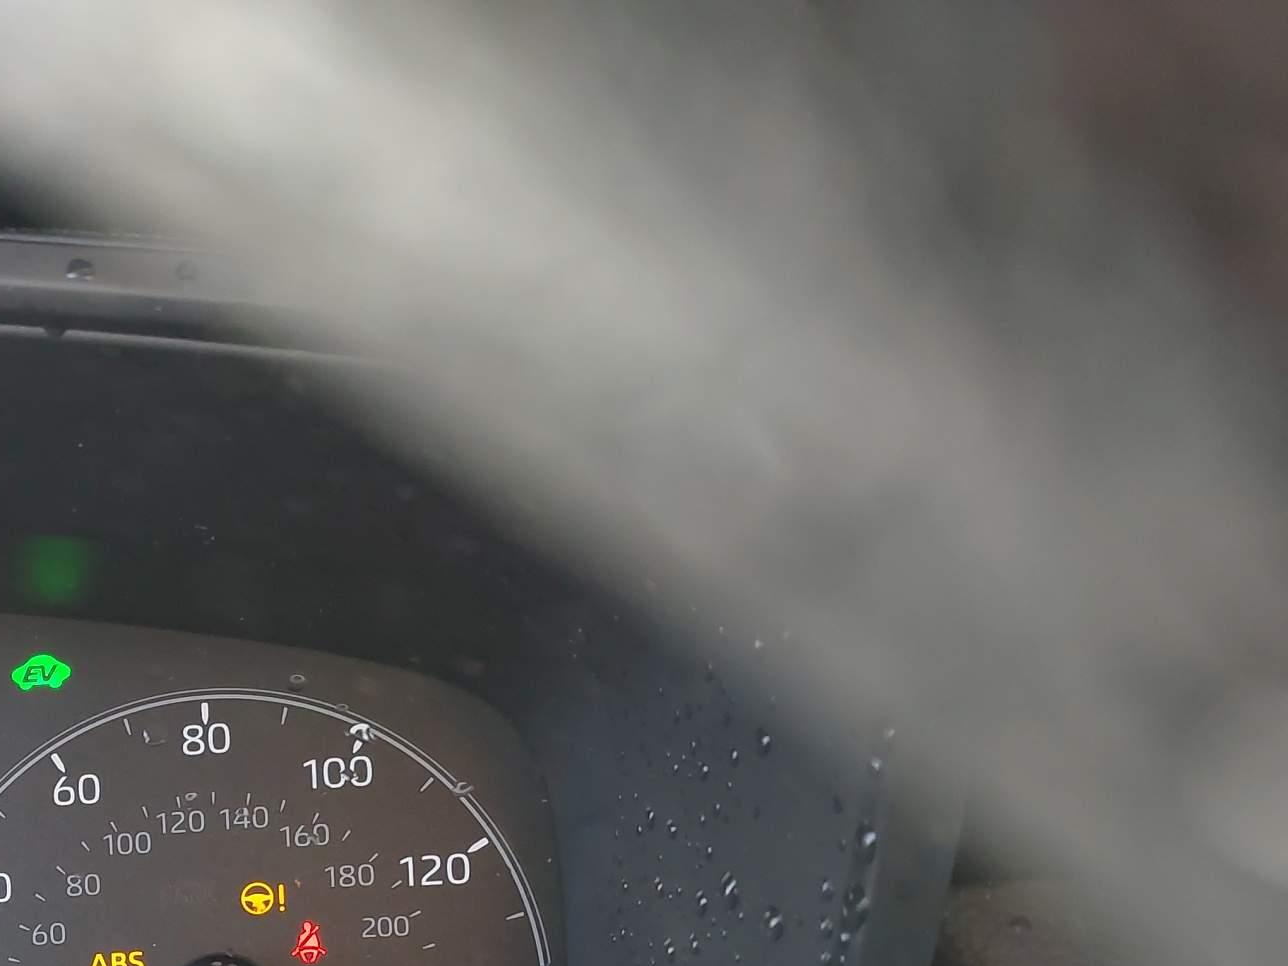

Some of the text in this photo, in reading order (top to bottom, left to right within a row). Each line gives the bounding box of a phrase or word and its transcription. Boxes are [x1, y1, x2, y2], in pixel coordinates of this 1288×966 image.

[23, 664, 57, 682] EV
[182, 723, 230, 755] 80
[303, 756, 373, 789] 100
[53, 774, 100, 805] 60
[157, 810, 204, 833] 120
[220, 806, 268, 830] 140
[103, 832, 151, 854] 100
[280, 823, 329, 847] 160
[325, 864, 374, 887] 180
[400, 853, 470, 886] 120
[67, 874, 100, 895] 80
[32, 923, 65, 945] 60
[362, 916, 409, 937] 200
